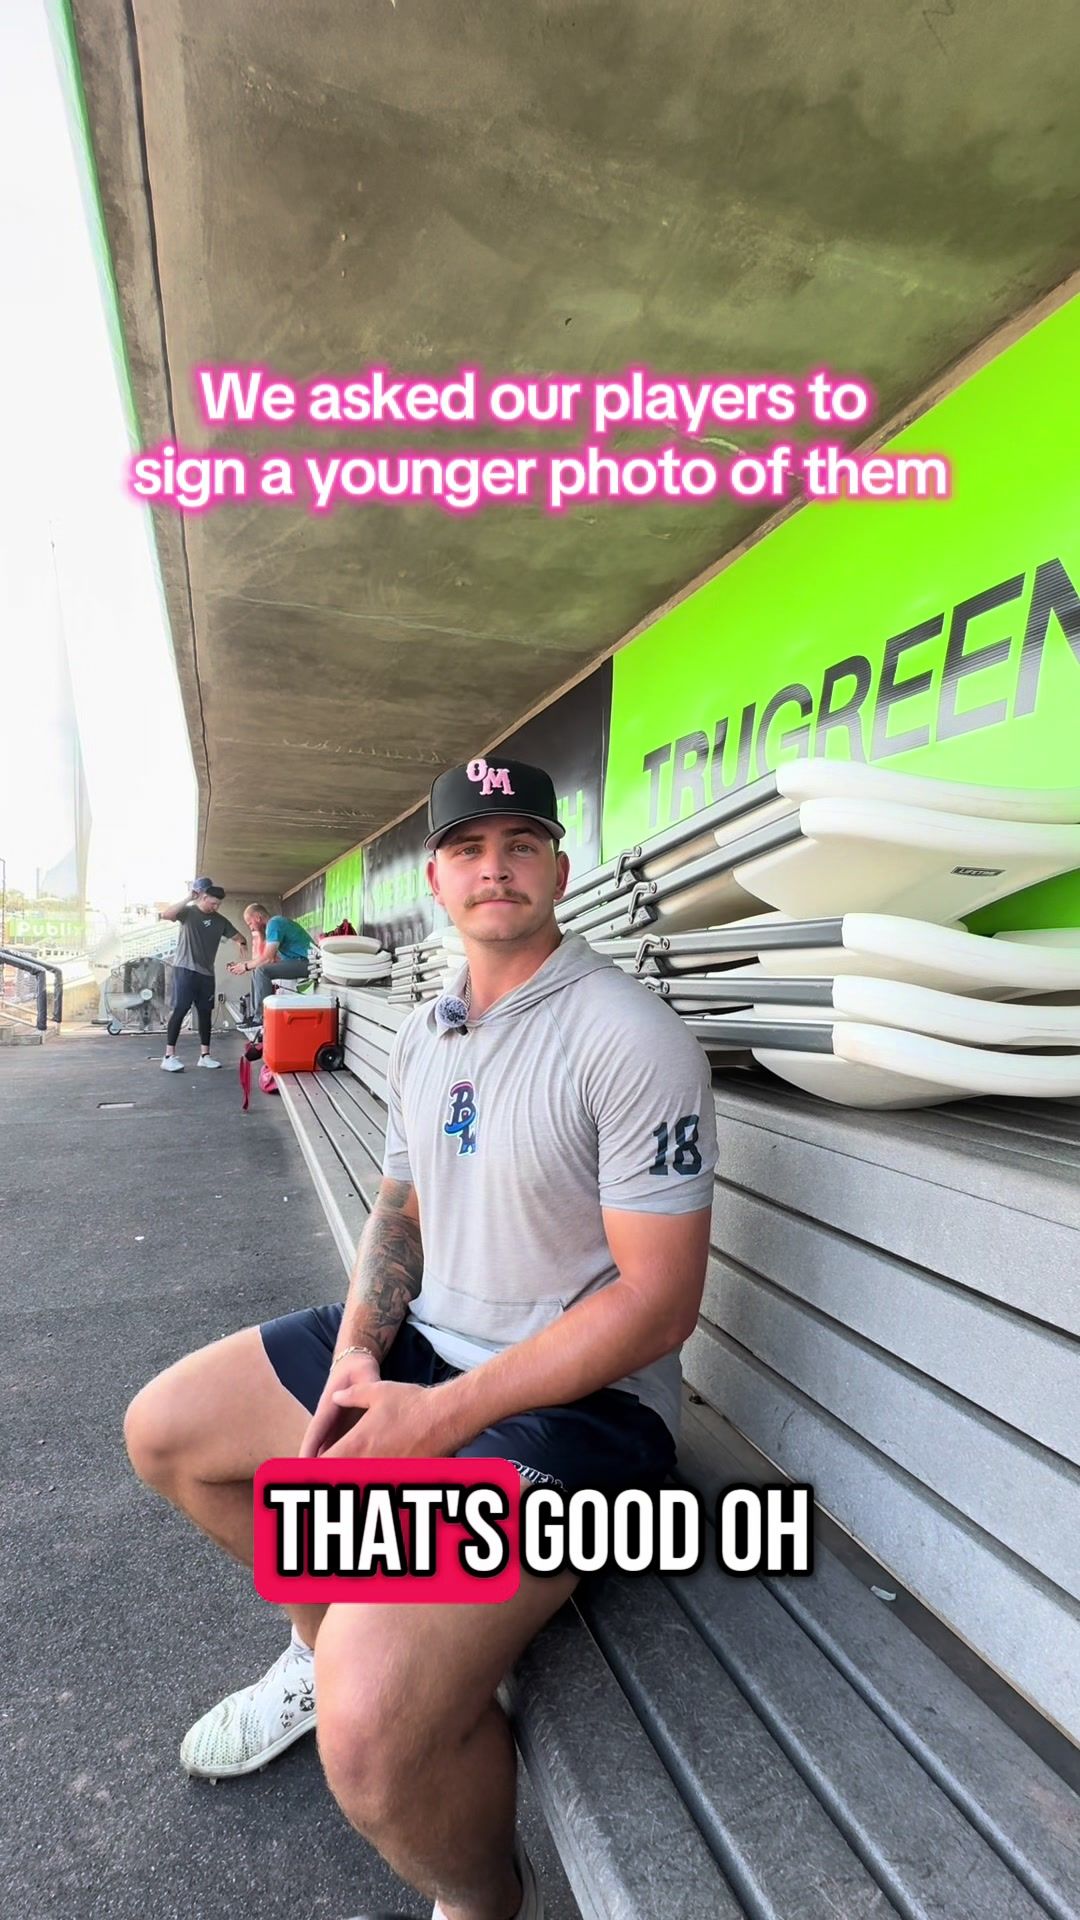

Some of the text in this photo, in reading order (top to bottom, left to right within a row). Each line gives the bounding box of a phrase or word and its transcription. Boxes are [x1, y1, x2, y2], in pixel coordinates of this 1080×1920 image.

[642, 557, 1080, 829] TRUGREEN
[466, 758, 515, 796] OM
[649, 1114, 703, 1177] 18
